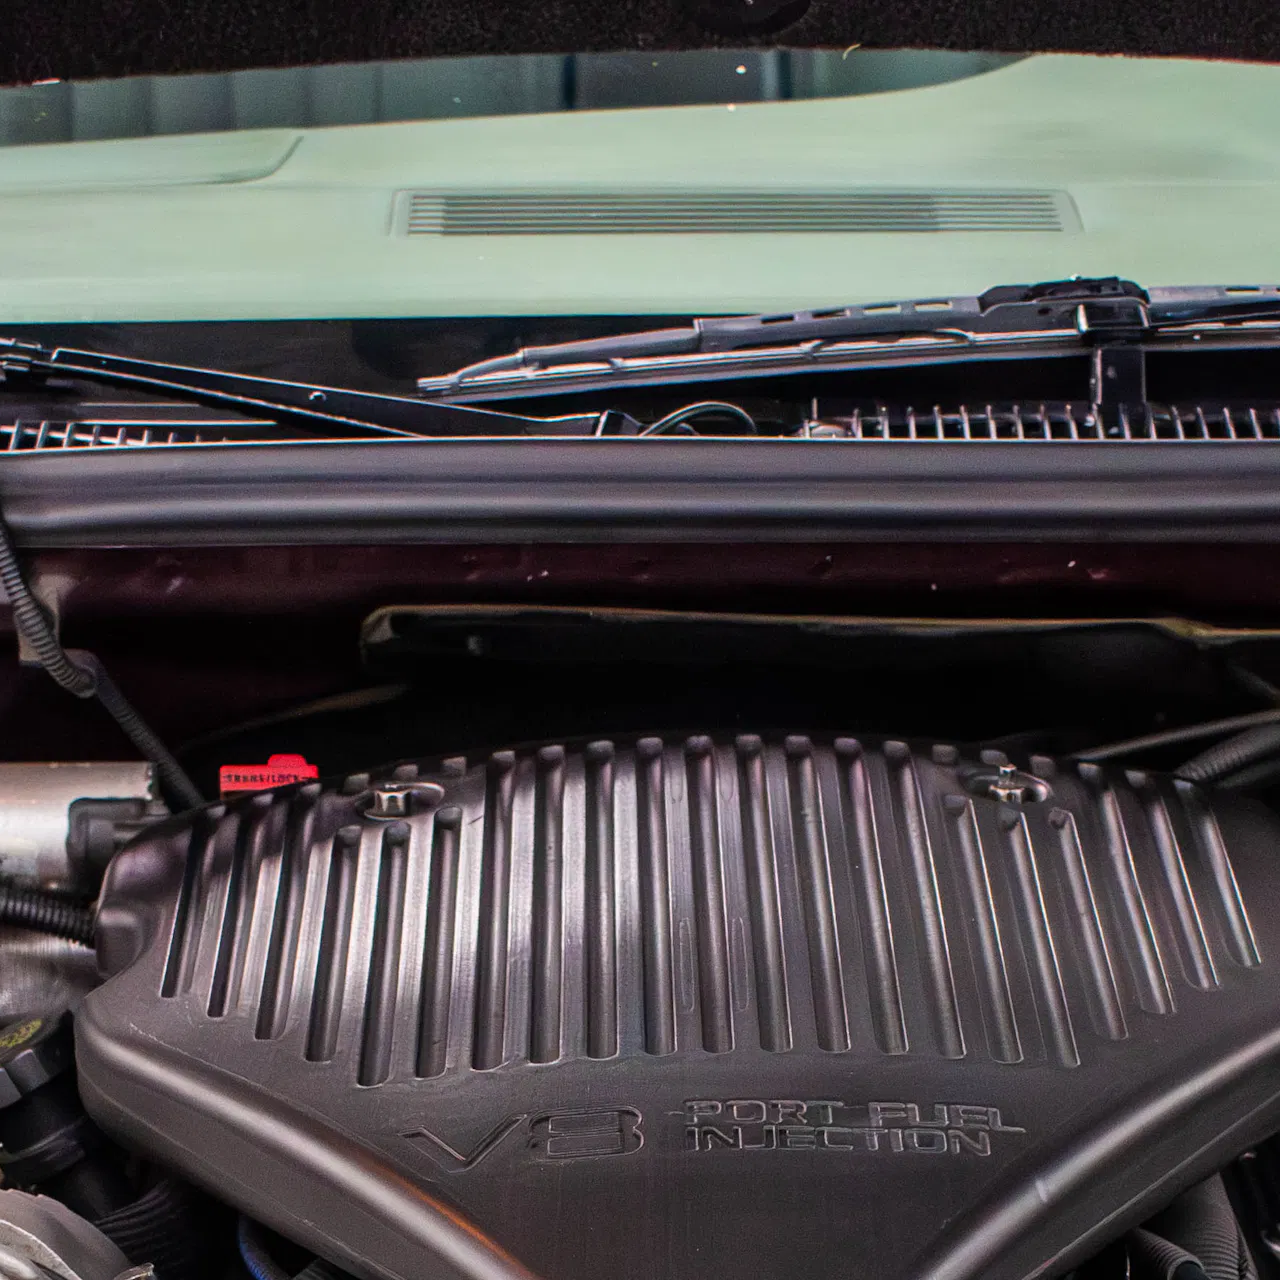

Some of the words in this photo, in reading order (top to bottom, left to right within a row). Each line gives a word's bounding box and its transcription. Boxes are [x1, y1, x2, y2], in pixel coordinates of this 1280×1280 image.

[683, 1100, 846, 1125] PORT
[867, 1100, 1023, 1131] FUEL
[401, 1104, 646, 1173] V8
[684, 1126, 992, 1156] INJECTION
